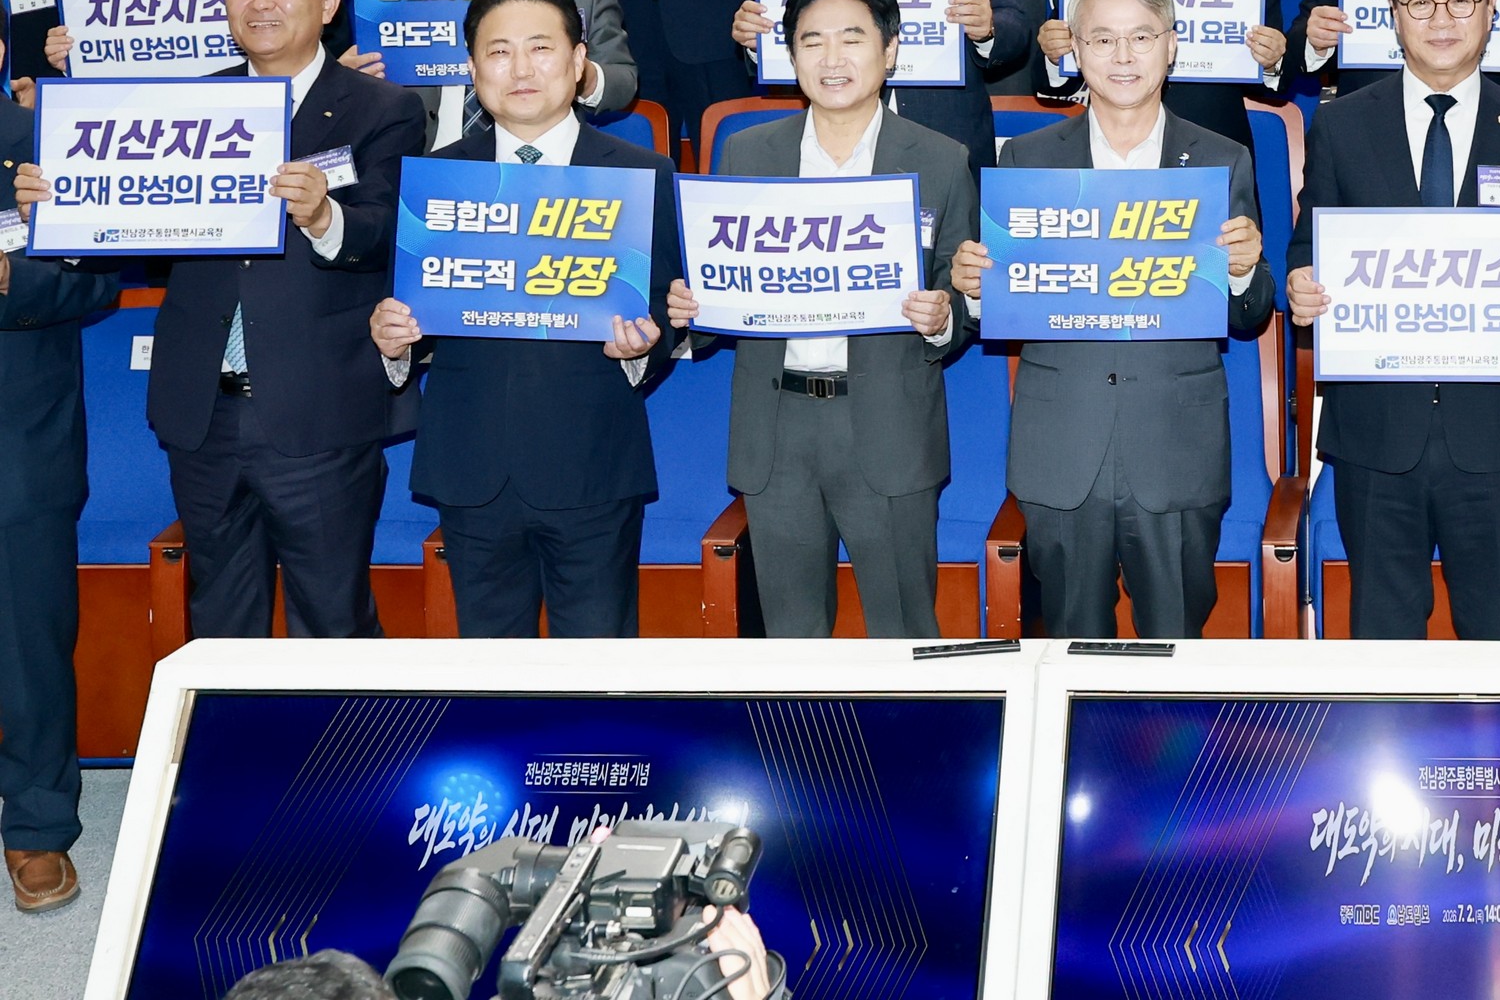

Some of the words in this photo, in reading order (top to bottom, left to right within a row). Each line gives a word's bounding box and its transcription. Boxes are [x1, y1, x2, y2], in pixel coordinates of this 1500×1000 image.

[379, 21, 456, 46] 압도적
[79, 38, 126, 63] 인재
[129, 35, 198, 60] 양성의
[66, 119, 254, 160] 지산지소
[55, 176, 110, 205] 인재
[119, 175, 202, 205] 양성의
[209, 174, 268, 204] 요람
[122, 228, 223, 238] 전남광주통합특별시교육청
[426, 200, 518, 234] 통합의
[527, 198, 621, 240] 비전
[1009, 208, 1099, 238] 통합의
[1109, 199, 1198, 240] 비전
[708, 214, 885, 253] 지산지소
[423, 257, 515, 290] 압도적
[525, 255, 617, 296] 성장
[701, 264, 752, 292] 인재
[759, 266, 840, 293] 양성의
[847, 263, 903, 291] 요람
[1009, 263, 1098, 293] 압도적
[1108, 256, 1196, 296] 성장
[462, 311, 578, 328] 전남광주통합특별시
[767, 311, 864, 323] 전남광주통합특별시교육청
[1049, 314, 1159, 328] 전남광주통합특별시
[1334, 304, 1387, 332] 인재
[1395, 304, 1475, 332] 양성의
[1400, 355, 1499, 368] 전남광주통합특별시교육청
[525, 761, 608, 787] 전남광주통합특별시
[610, 762, 629, 786] 출범
[630, 762, 651, 787] 기념
